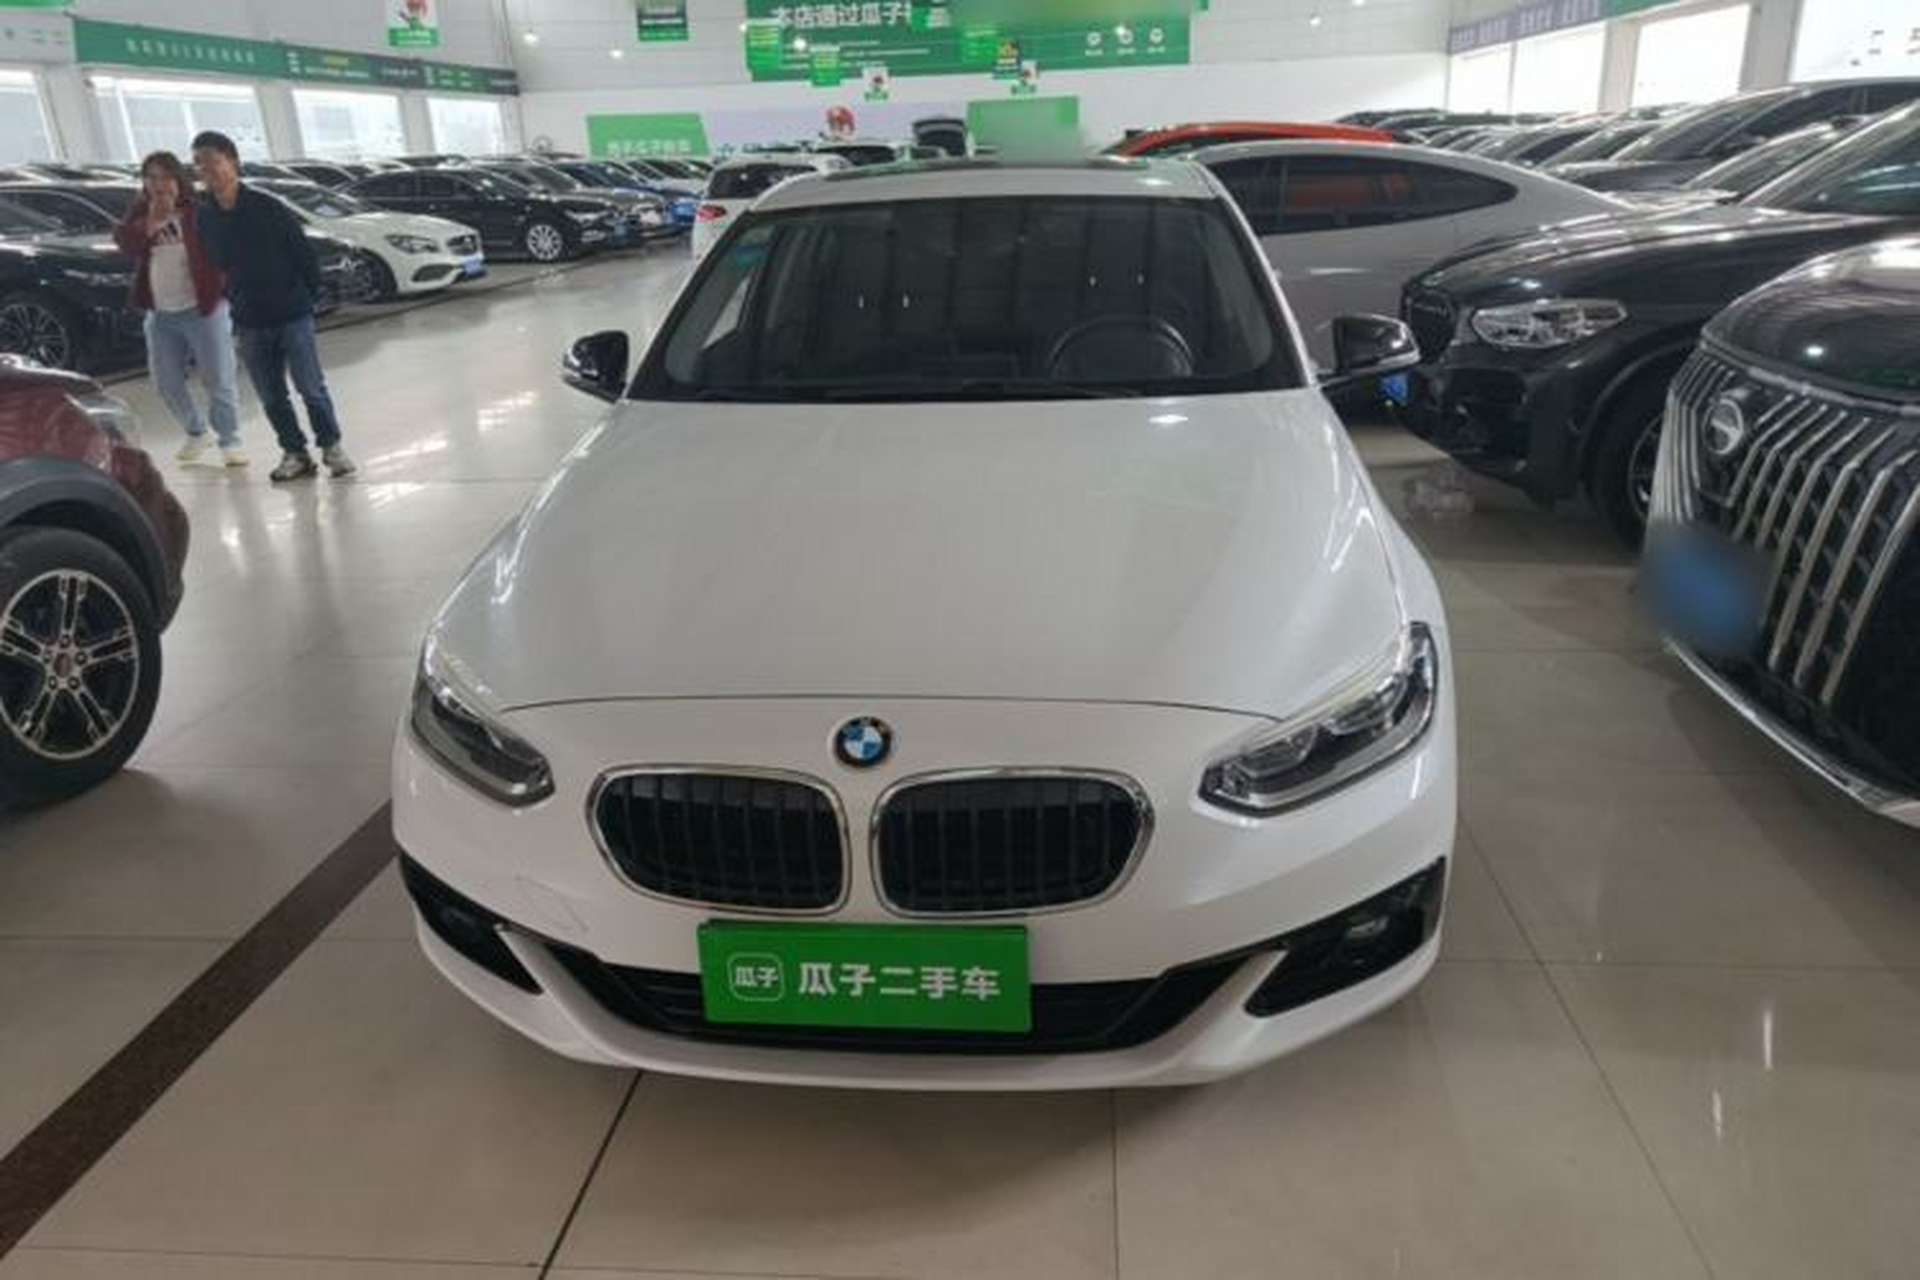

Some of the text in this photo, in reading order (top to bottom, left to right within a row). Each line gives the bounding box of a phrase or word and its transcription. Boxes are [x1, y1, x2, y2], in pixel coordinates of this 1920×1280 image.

[735, 966, 778, 988] 瓜子
[799, 962, 1000, 1000] 瓜子二手车
